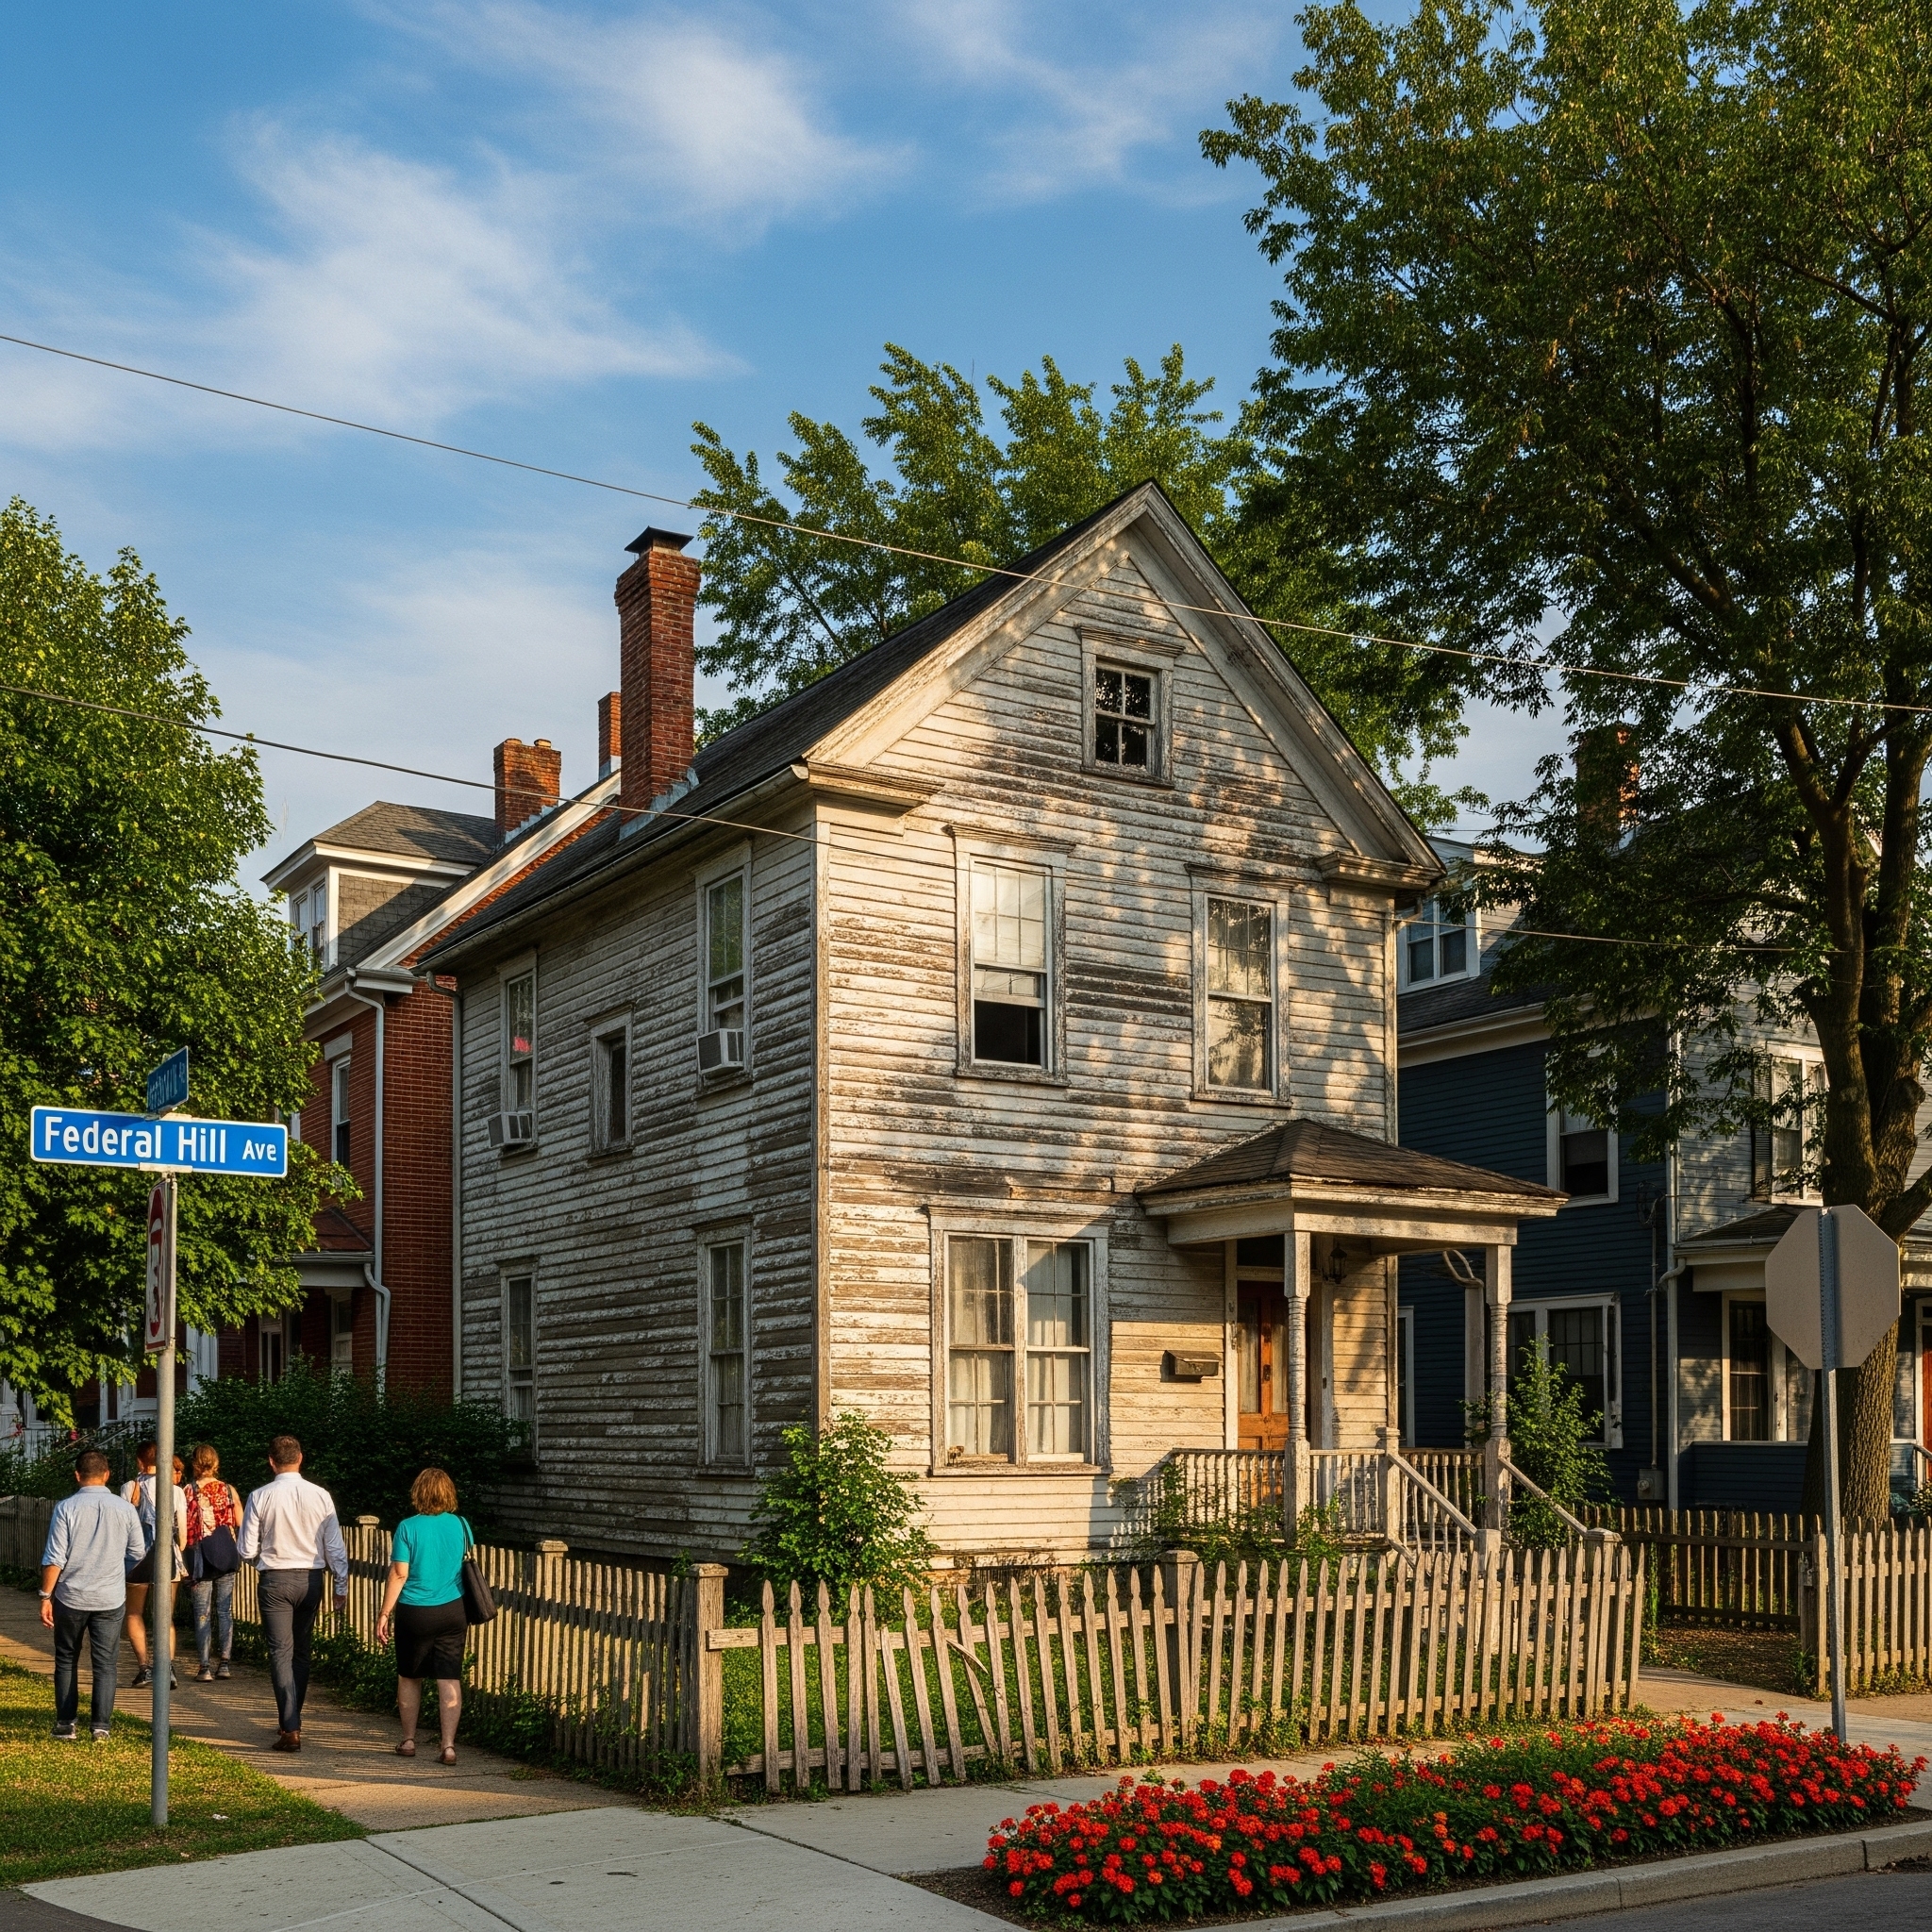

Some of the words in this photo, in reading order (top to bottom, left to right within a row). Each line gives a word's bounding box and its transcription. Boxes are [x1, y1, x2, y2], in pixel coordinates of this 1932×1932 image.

[45, 1116, 161, 1159] Federal
[178, 1125, 226, 1163] Hill
[242, 1139, 277, 1161] Ave
